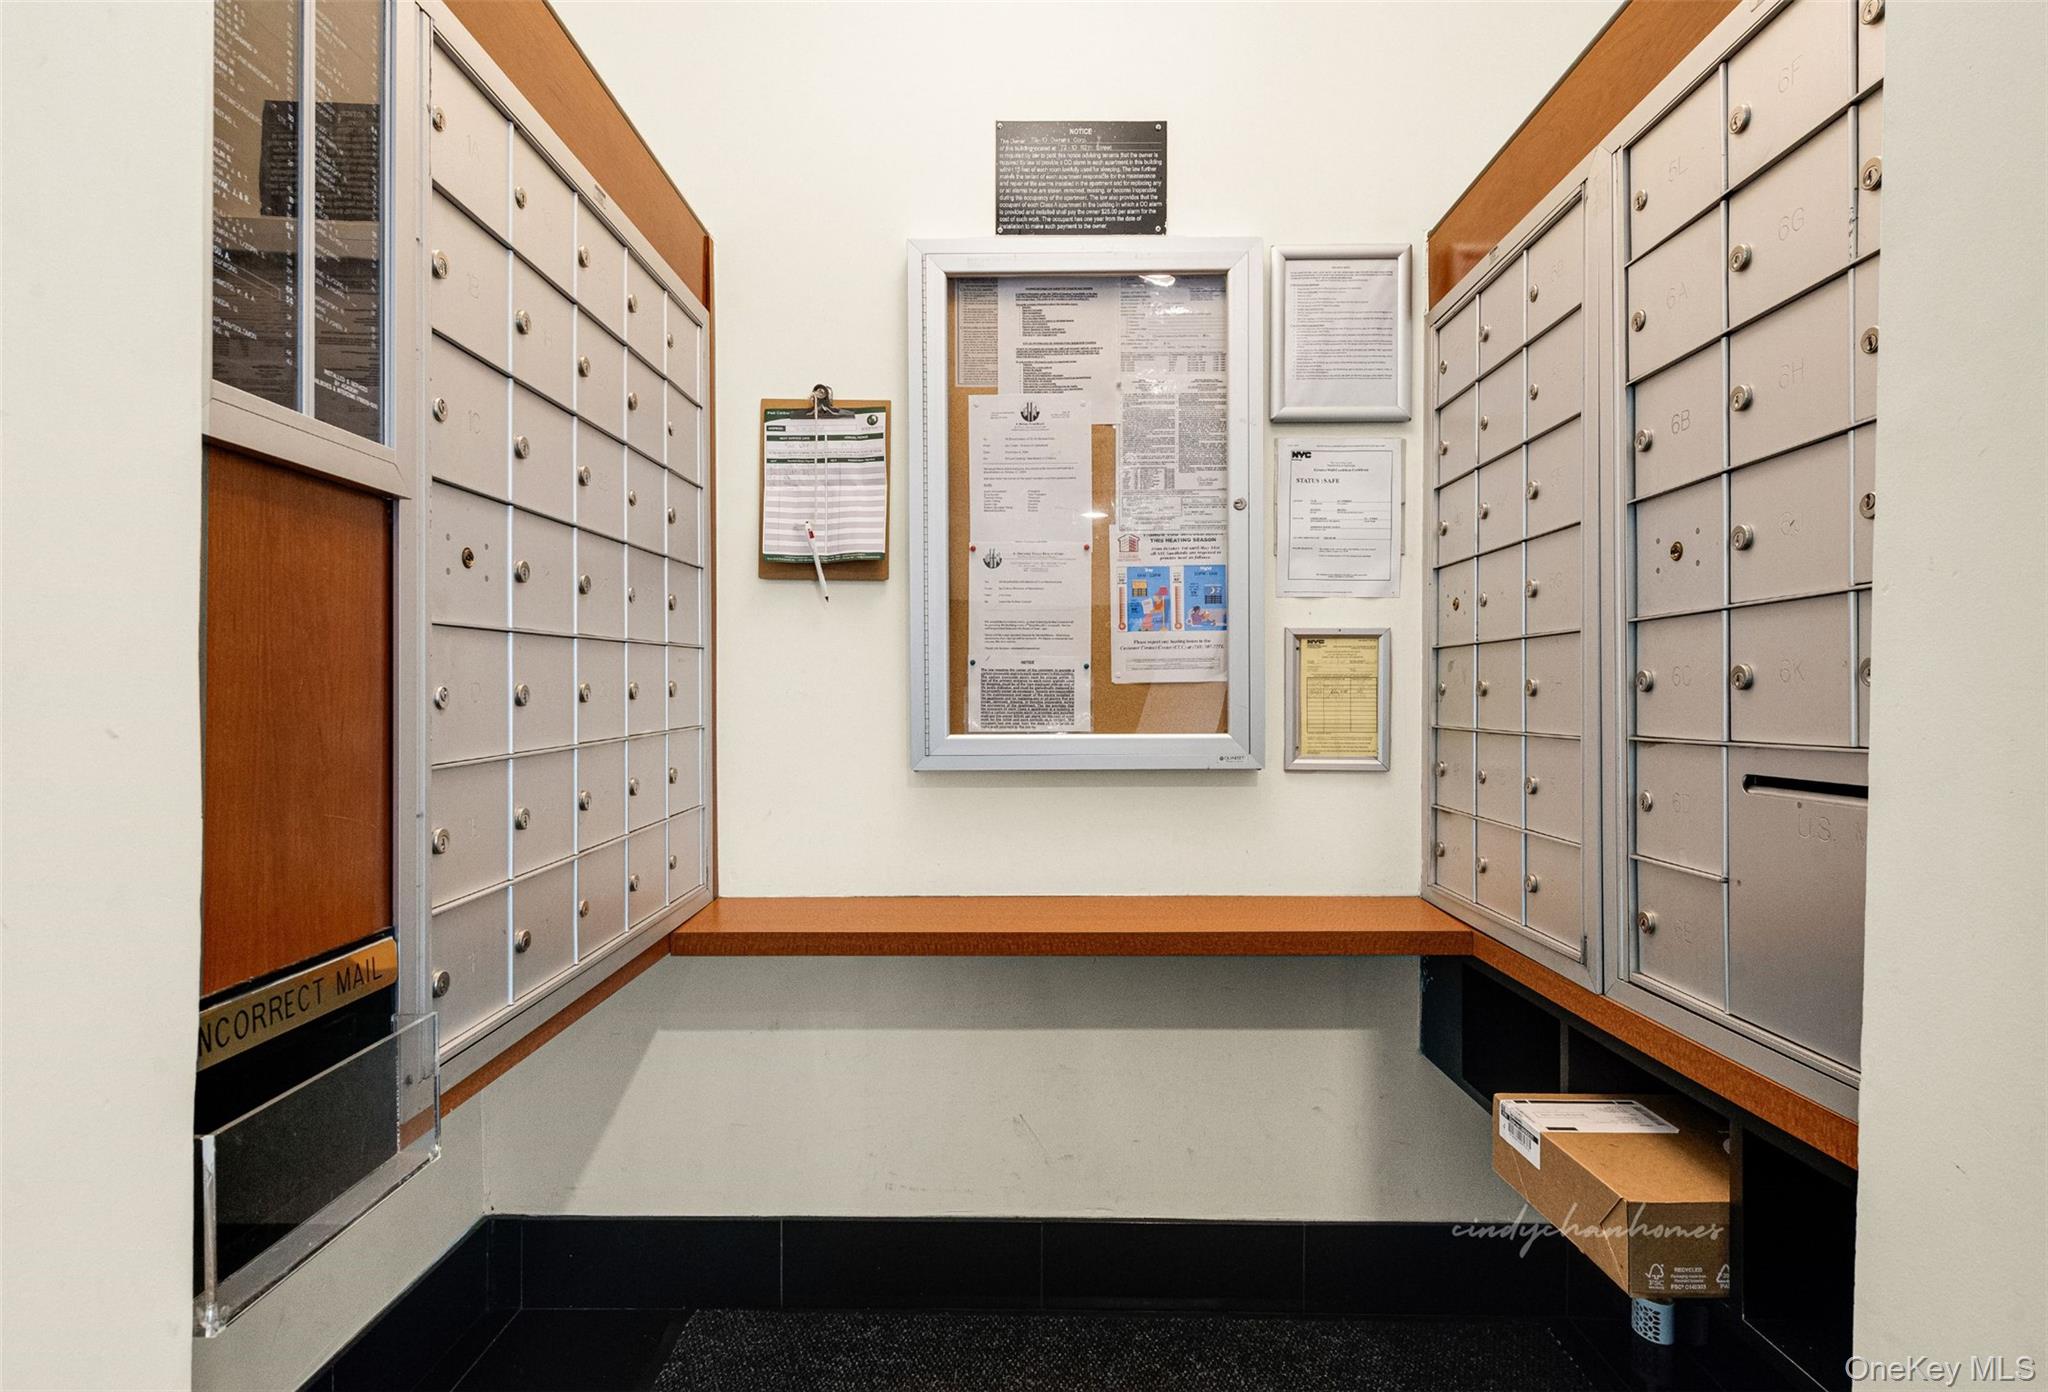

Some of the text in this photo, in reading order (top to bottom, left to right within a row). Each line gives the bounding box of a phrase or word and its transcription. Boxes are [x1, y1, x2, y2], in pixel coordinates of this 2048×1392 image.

[1671, 409, 1691, 434] 6B
[1291, 451, 1312, 459] NYC
[199, 956, 383, 1057] NCORRECT MAIL
